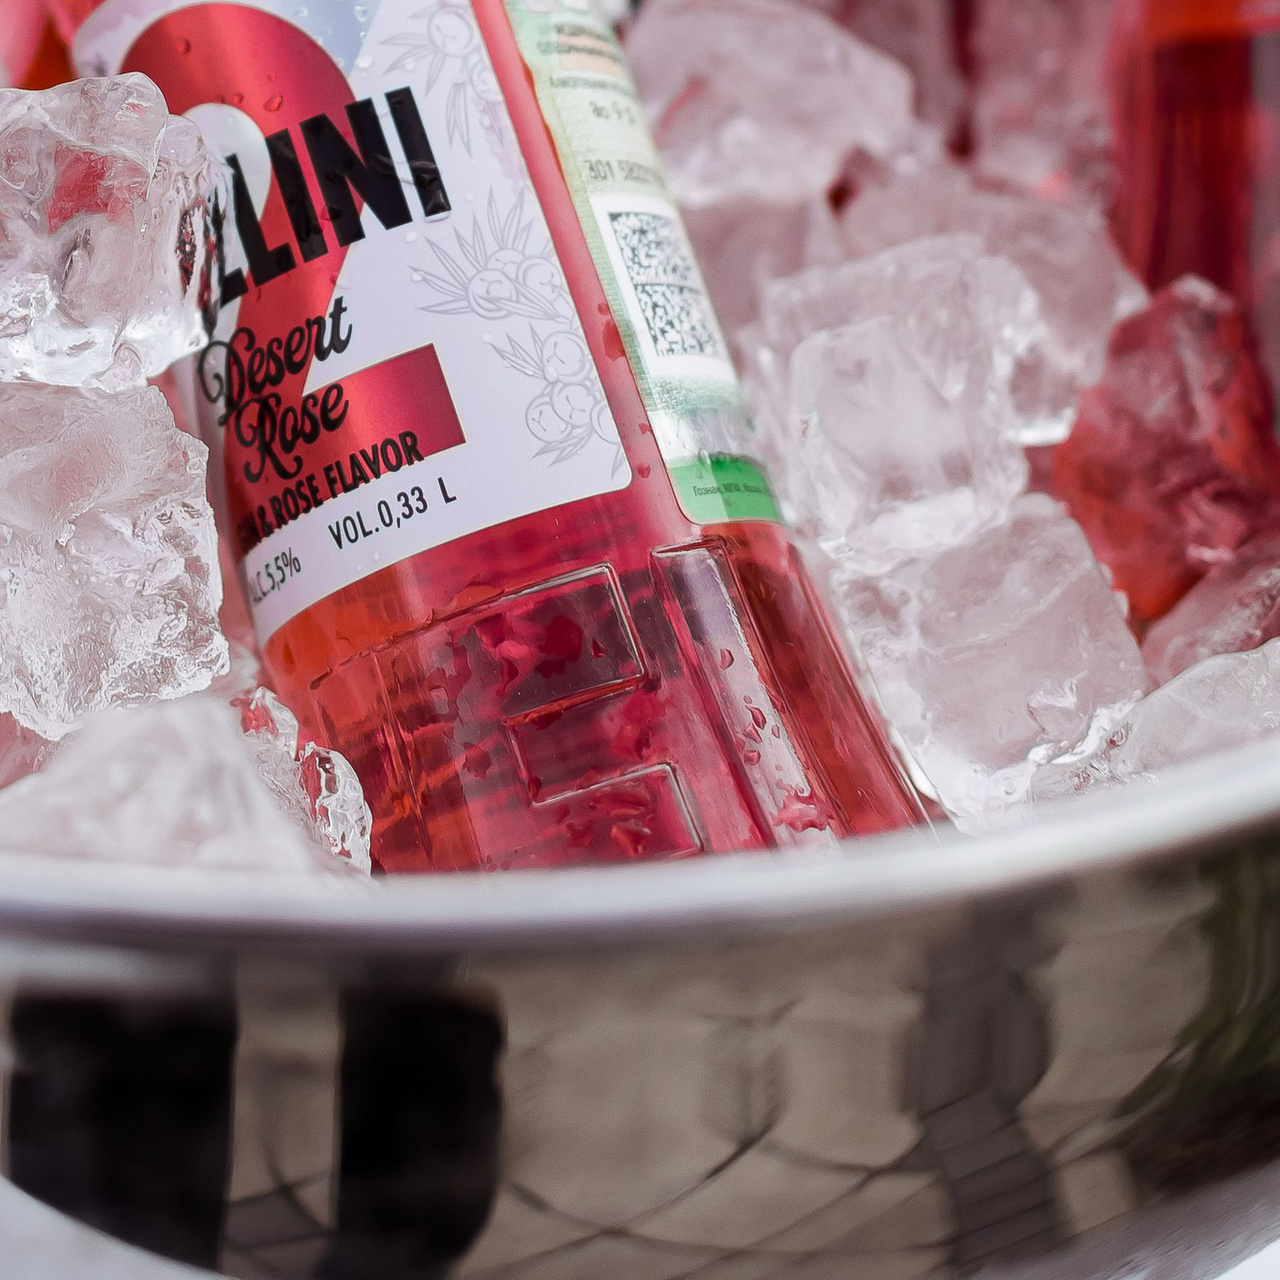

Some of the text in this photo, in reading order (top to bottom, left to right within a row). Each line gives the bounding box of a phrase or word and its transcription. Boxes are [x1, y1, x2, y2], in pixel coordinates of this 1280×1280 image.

[198, 295, 353, 427] Desert
[234, 383, 349, 484] Rose
[272, 474, 324, 530] ROSE
[323, 430, 424, 499] FLAVOR
[437, 476, 457, 504] L
